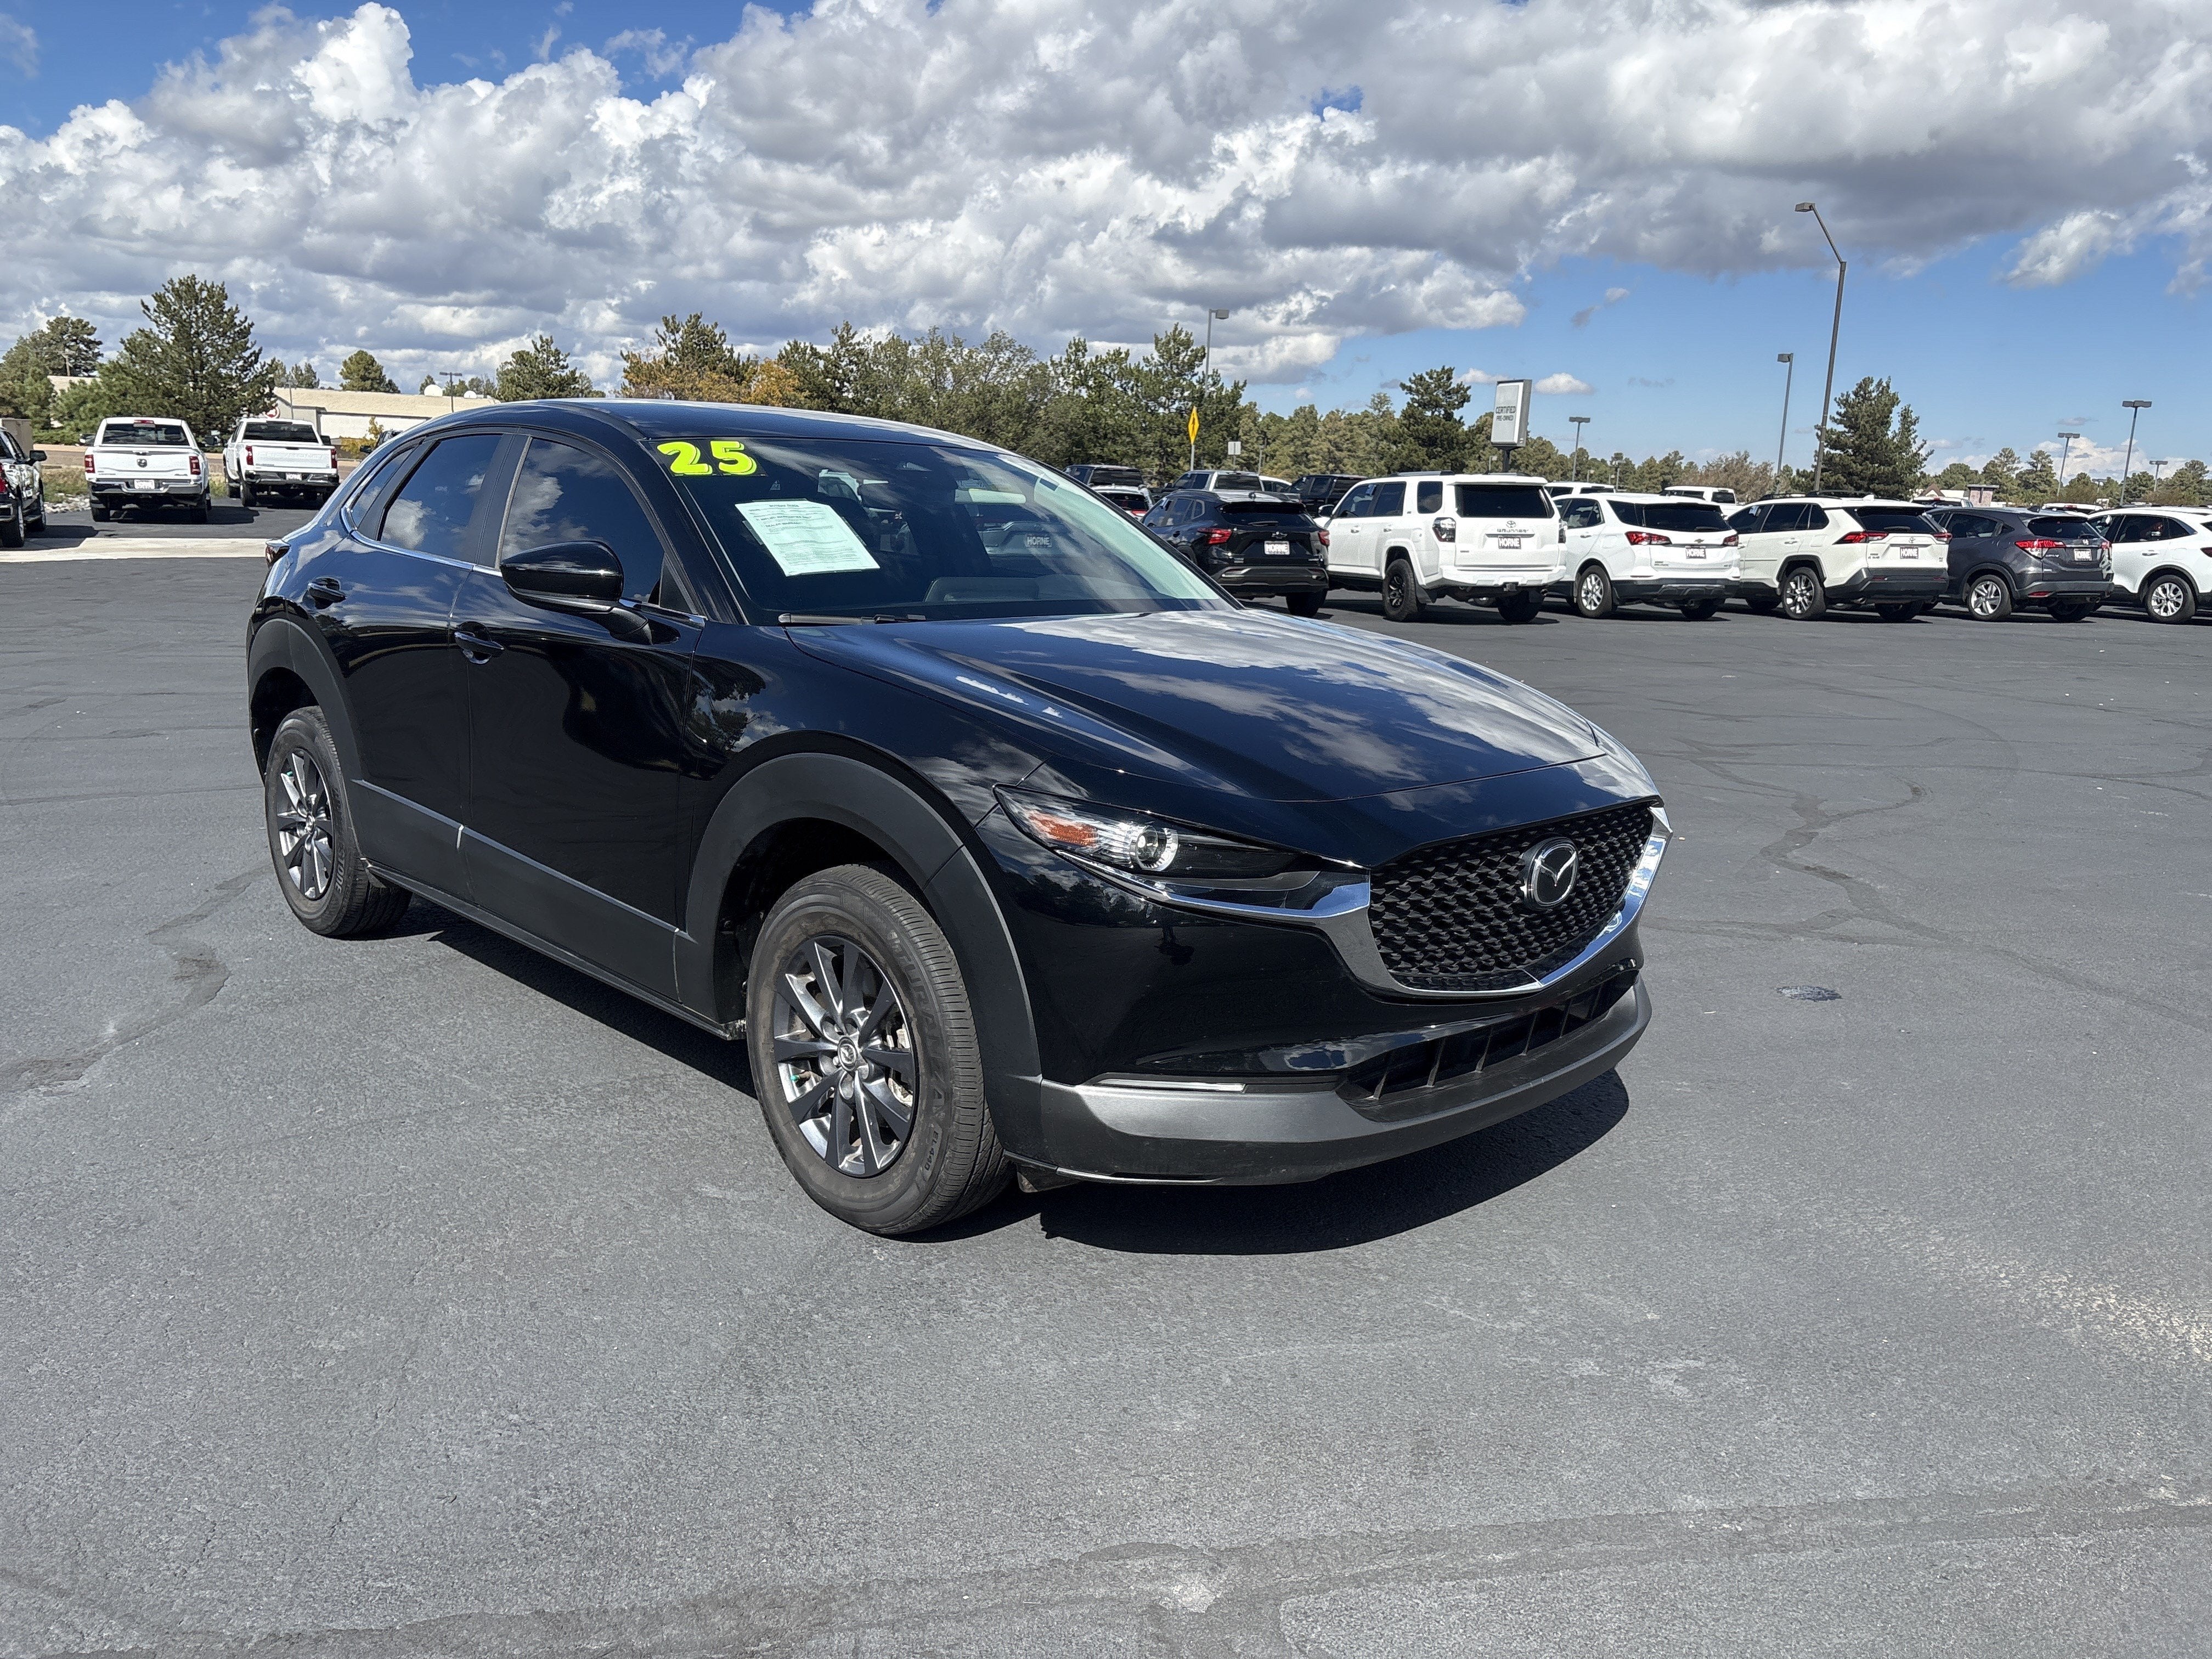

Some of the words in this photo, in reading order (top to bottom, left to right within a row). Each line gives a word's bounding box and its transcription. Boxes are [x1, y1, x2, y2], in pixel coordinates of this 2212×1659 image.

[657, 441, 757, 475] 25
[1027, 537, 1050, 545] HORNE
[1499, 538, 1520, 547] HORNE
[1266, 543, 1288, 552] HORNE
[1686, 549, 1705, 557] HORNE
[1900, 548, 1918, 557] HORNE
